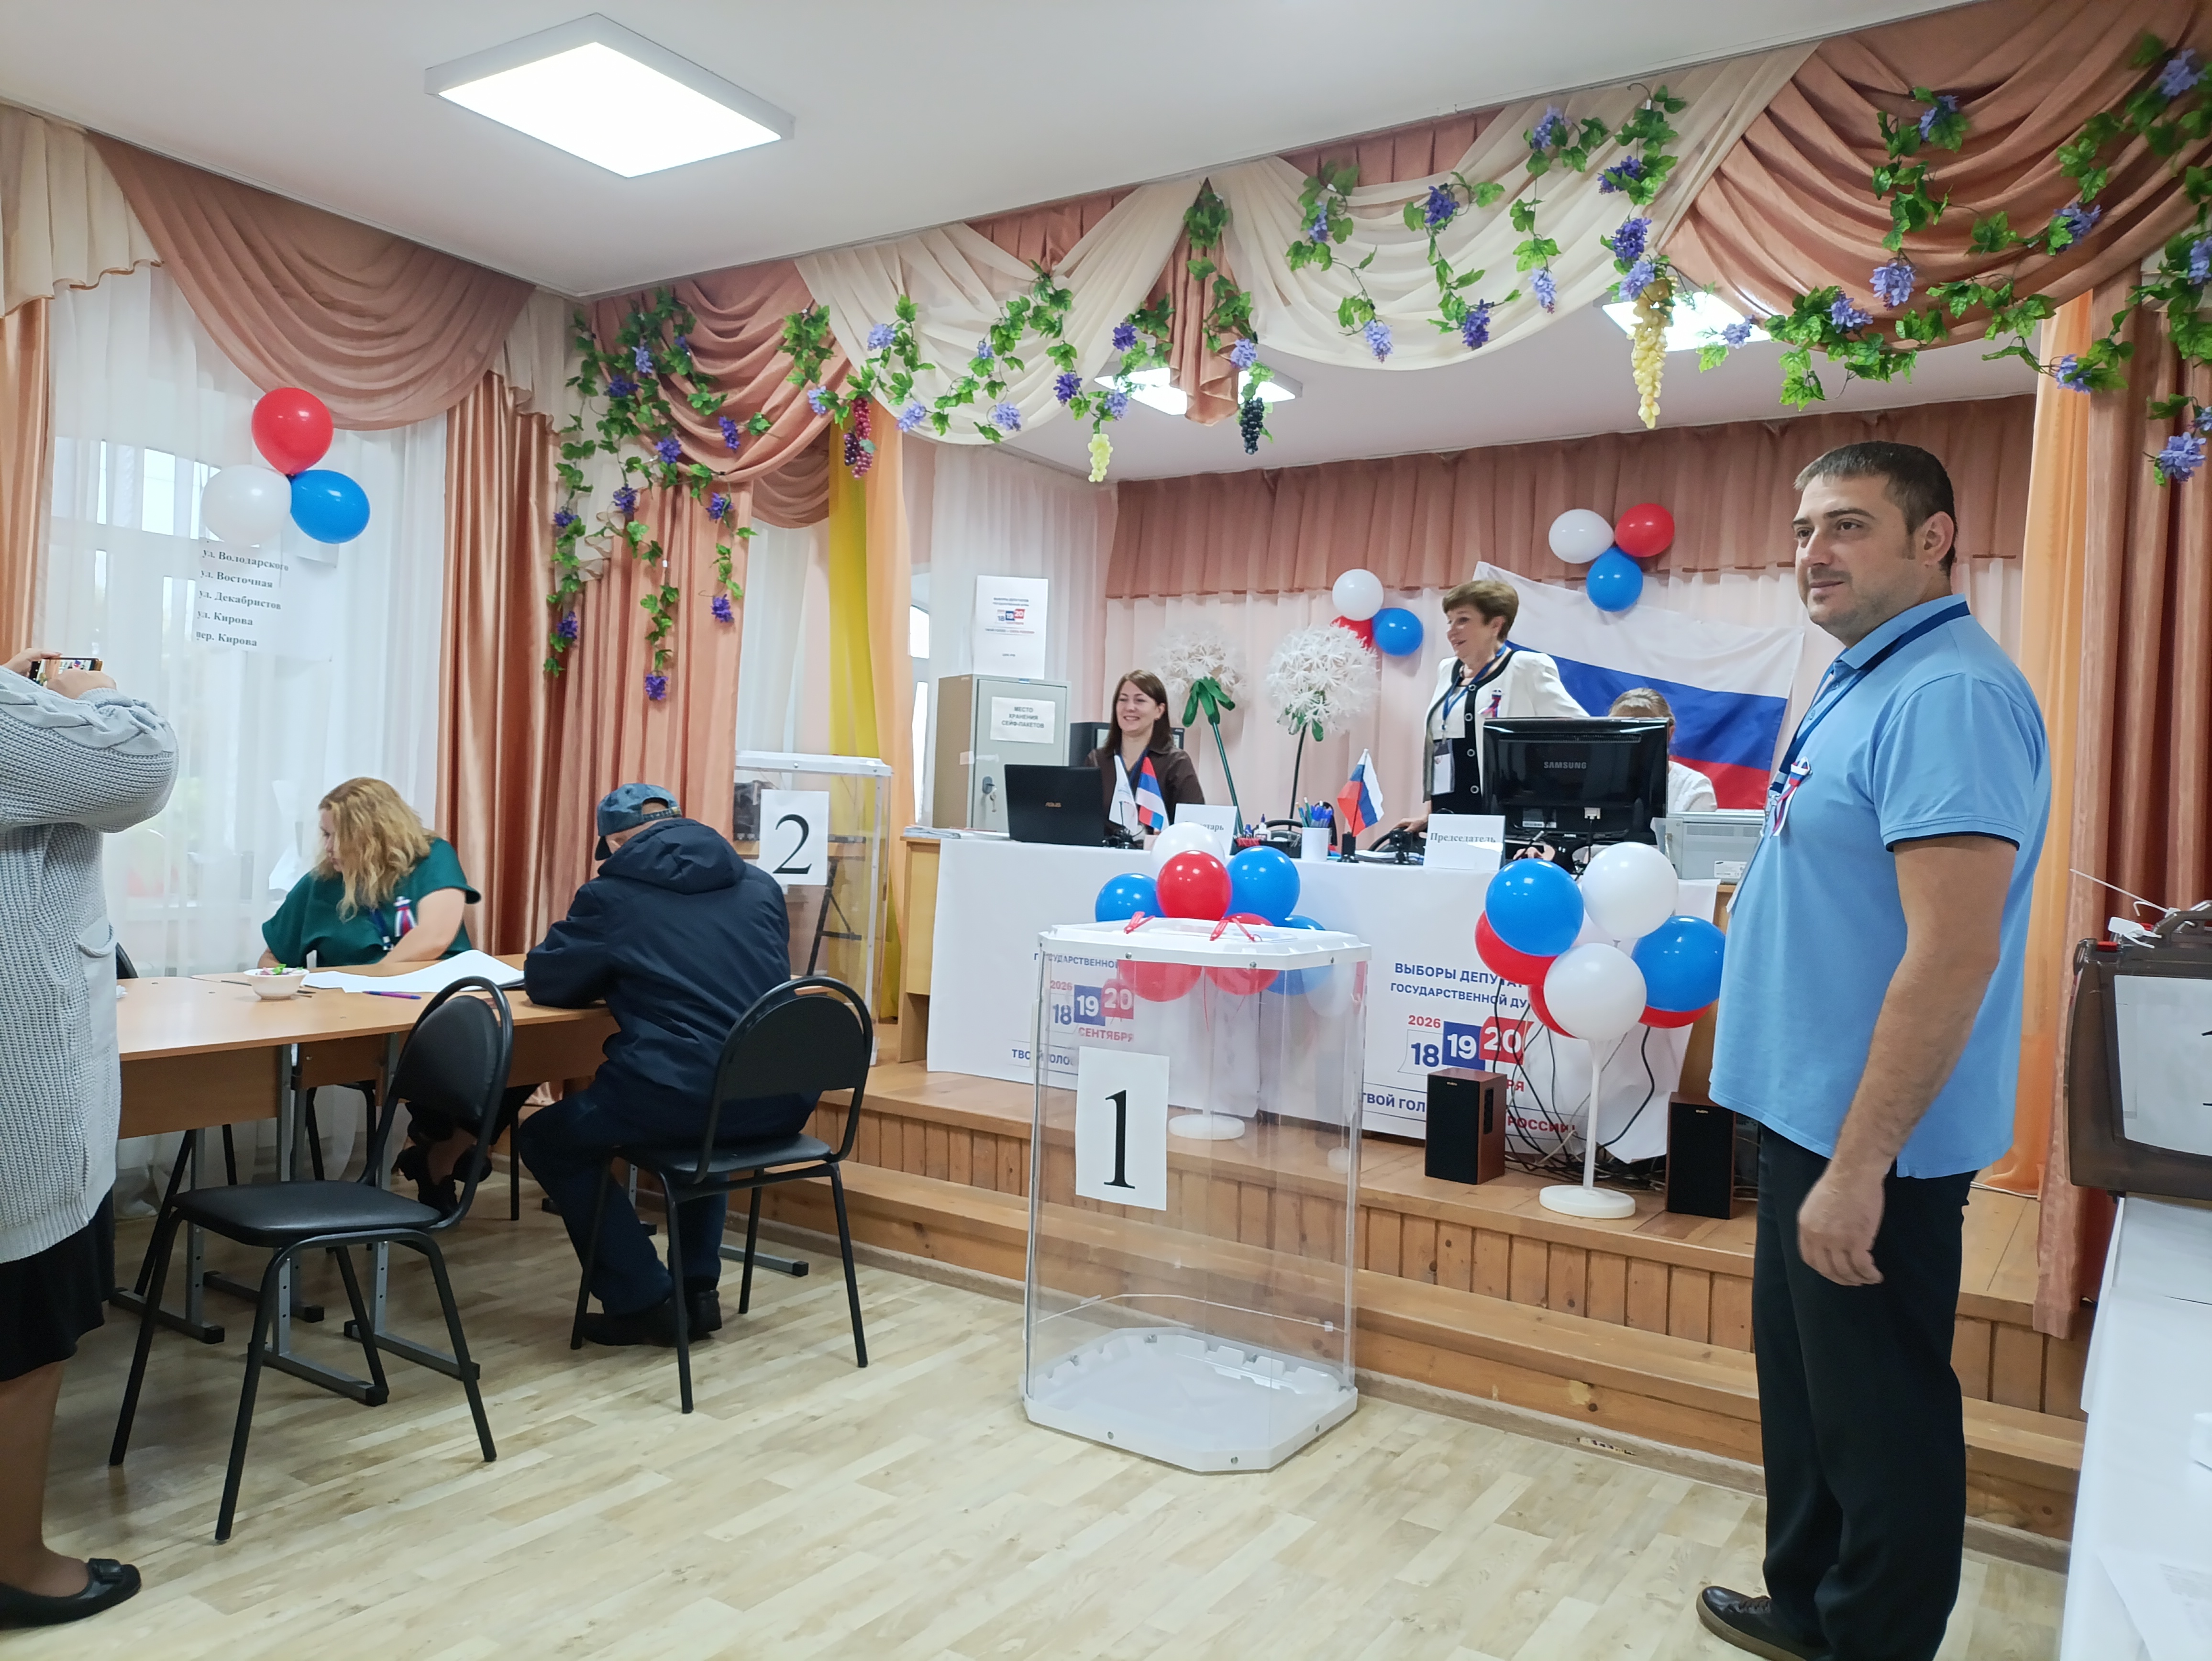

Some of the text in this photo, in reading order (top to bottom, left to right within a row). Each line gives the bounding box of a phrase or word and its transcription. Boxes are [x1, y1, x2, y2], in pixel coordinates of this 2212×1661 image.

[217, 571, 273, 588] Восточная
[199, 590, 281, 610] ул. Декабристов
[197, 610, 253, 625] ул. Кирова
[196, 631, 258, 646] пер. Кирова
[1544, 761, 1587, 770] SAMSUNG
[773, 814, 812, 875] 2
[1430, 832, 1496, 843] Председатель
[1394, 962, 1522, 988] ВЫБОРЫ ДЕПУ
[1050, 980, 1073, 991] 2026
[1390, 982, 1527, 1008] ГОСУДАРСТВЕННОЙ ДУ
[1052, 987, 1133, 1025] 18 19 20
[1408, 1015, 1441, 1029] 2026
[1078, 1027, 1134, 1042] СЕНТЯБРЯ
[1411, 1026, 1522, 1068] 18 19 20
[1399, 1098, 1425, 1112] ГОЛ
[1103, 1089, 1136, 1190] 1
